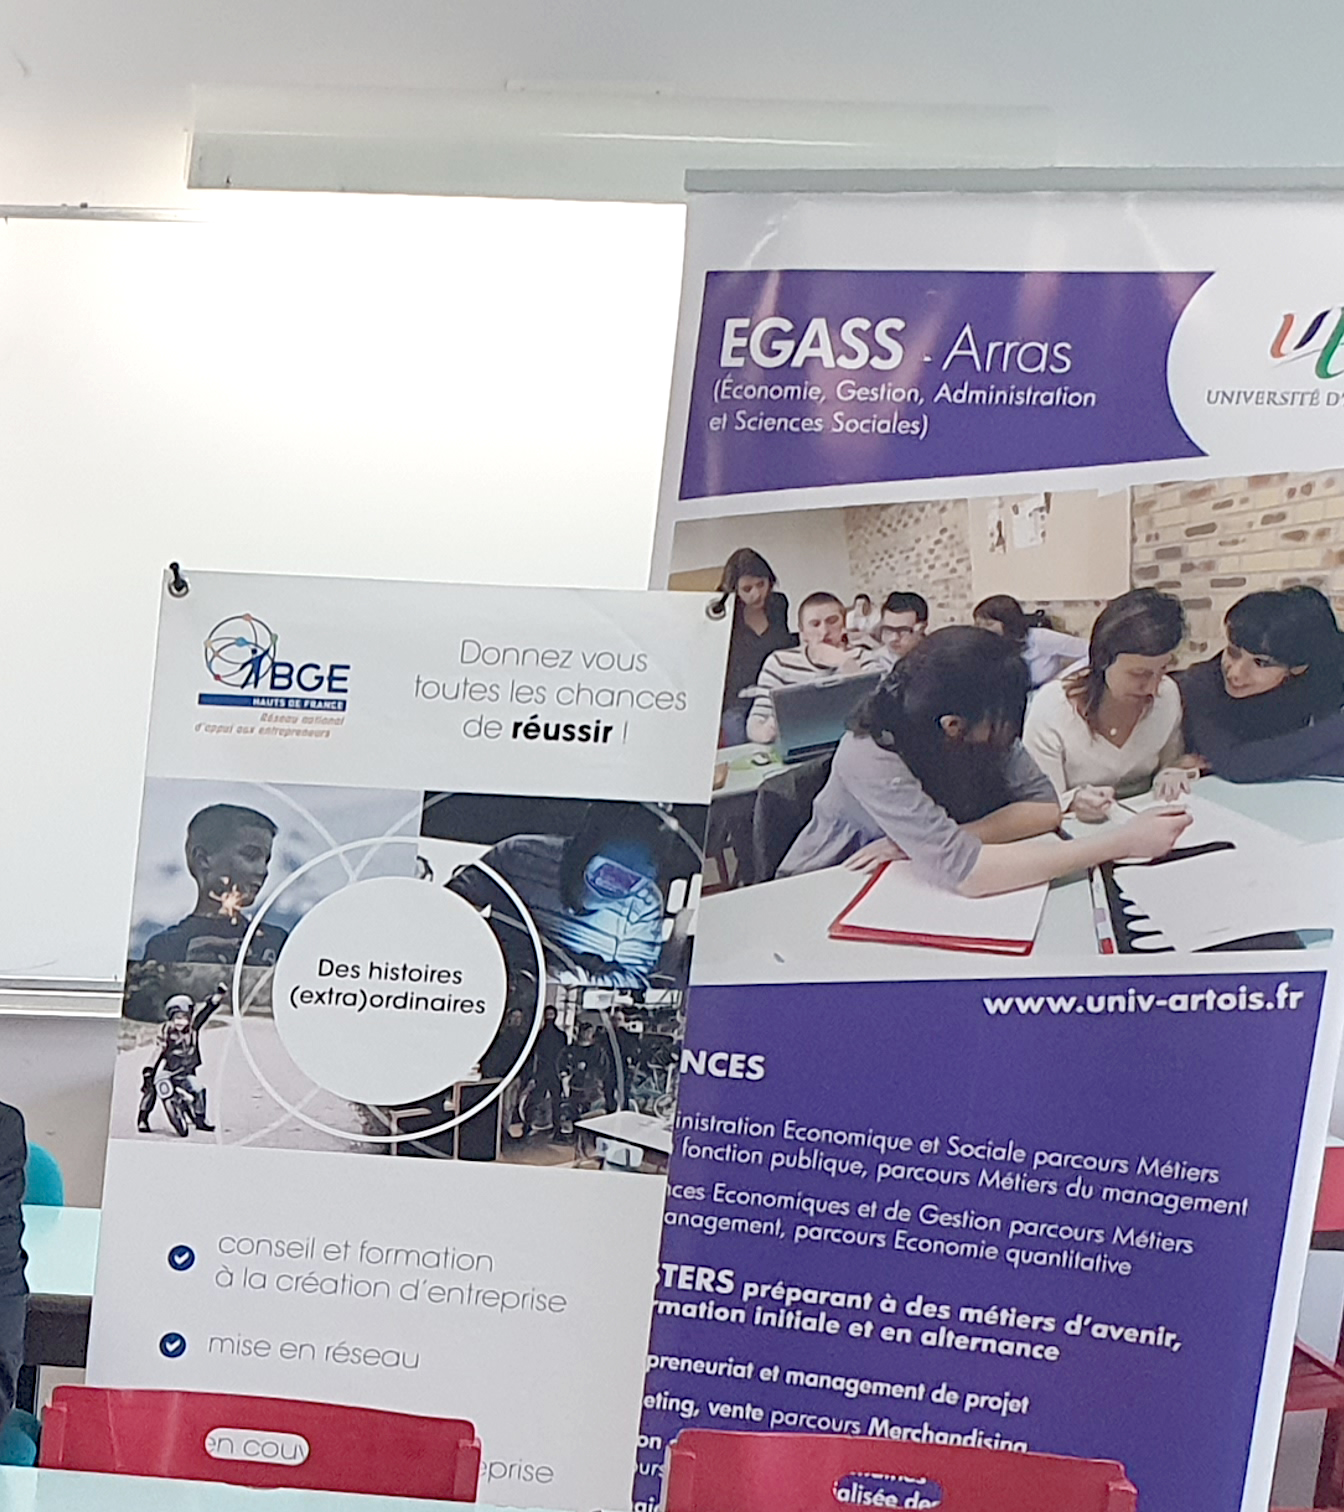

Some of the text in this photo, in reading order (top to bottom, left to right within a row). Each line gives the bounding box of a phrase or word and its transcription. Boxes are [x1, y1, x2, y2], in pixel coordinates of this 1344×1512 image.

[719, 317, 907, 371] EGASS
[942, 322, 1073, 375] Arras
[712, 373, 1096, 407] (Économie, Gestion, Administration
[1206, 388, 1321, 406] UNIVERSITÉ
[709, 410, 928, 440] et Sciences Sociales)
[460, 639, 648, 673] Donnez vous
[269, 662, 351, 693] BGE
[415, 674, 687, 711] toutes les chances
[252, 698, 344, 710] HAUTS DE FRANCE
[463, 714, 503, 739] de
[511, 713, 614, 744] réussir
[317, 958, 463, 985] Des histoires
[290, 985, 486, 1014] (extra)ordinaires
[983, 982, 1305, 1016] www.univ-artois.fr
[680, 1048, 766, 1081] NCES
[783, 1118, 913, 1154] Economique
[919, 1137, 941, 1155] et
[947, 1135, 1027, 1164] Sociale
[1033, 1149, 1130, 1175] parcours
[1137, 1156, 1220, 1185] Métiers
[682, 1136, 1249, 1219] fonction publique, parcours Métiers du management
[713, 1182, 850, 1217] Economiques
[858, 1201, 879, 1219] et
[884, 1200, 912, 1222] de
[918, 1203, 1001, 1232] Gestion
[1009, 1216, 1106, 1244] parcours
[1113, 1224, 1195, 1254] Métiers
[218, 1236, 494, 1272] conseil et formation
[794, 1224, 887, 1249] parcours
[894, 1229, 999, 1261] Economie
[1005, 1245, 1132, 1277] quantitative
[215, 1264, 568, 1314] à la création d'entreprise
[657, 1262, 1182, 1352] TERS préparant à des métiers d'avenir,
[208, 1333, 420, 1369] mise en réseau
[754, 1306, 840, 1335] initiale
[848, 1320, 874, 1339] et
[880, 1324, 913, 1343] en
[920, 1326, 1060, 1361] alternance
[759, 1364, 781, 1382] et
[785, 1368, 926, 1401] management
[931, 1382, 960, 1406] de
[964, 1391, 1030, 1417] projet
[707, 1402, 765, 1421] vente
[770, 1408, 861, 1435] parcours
